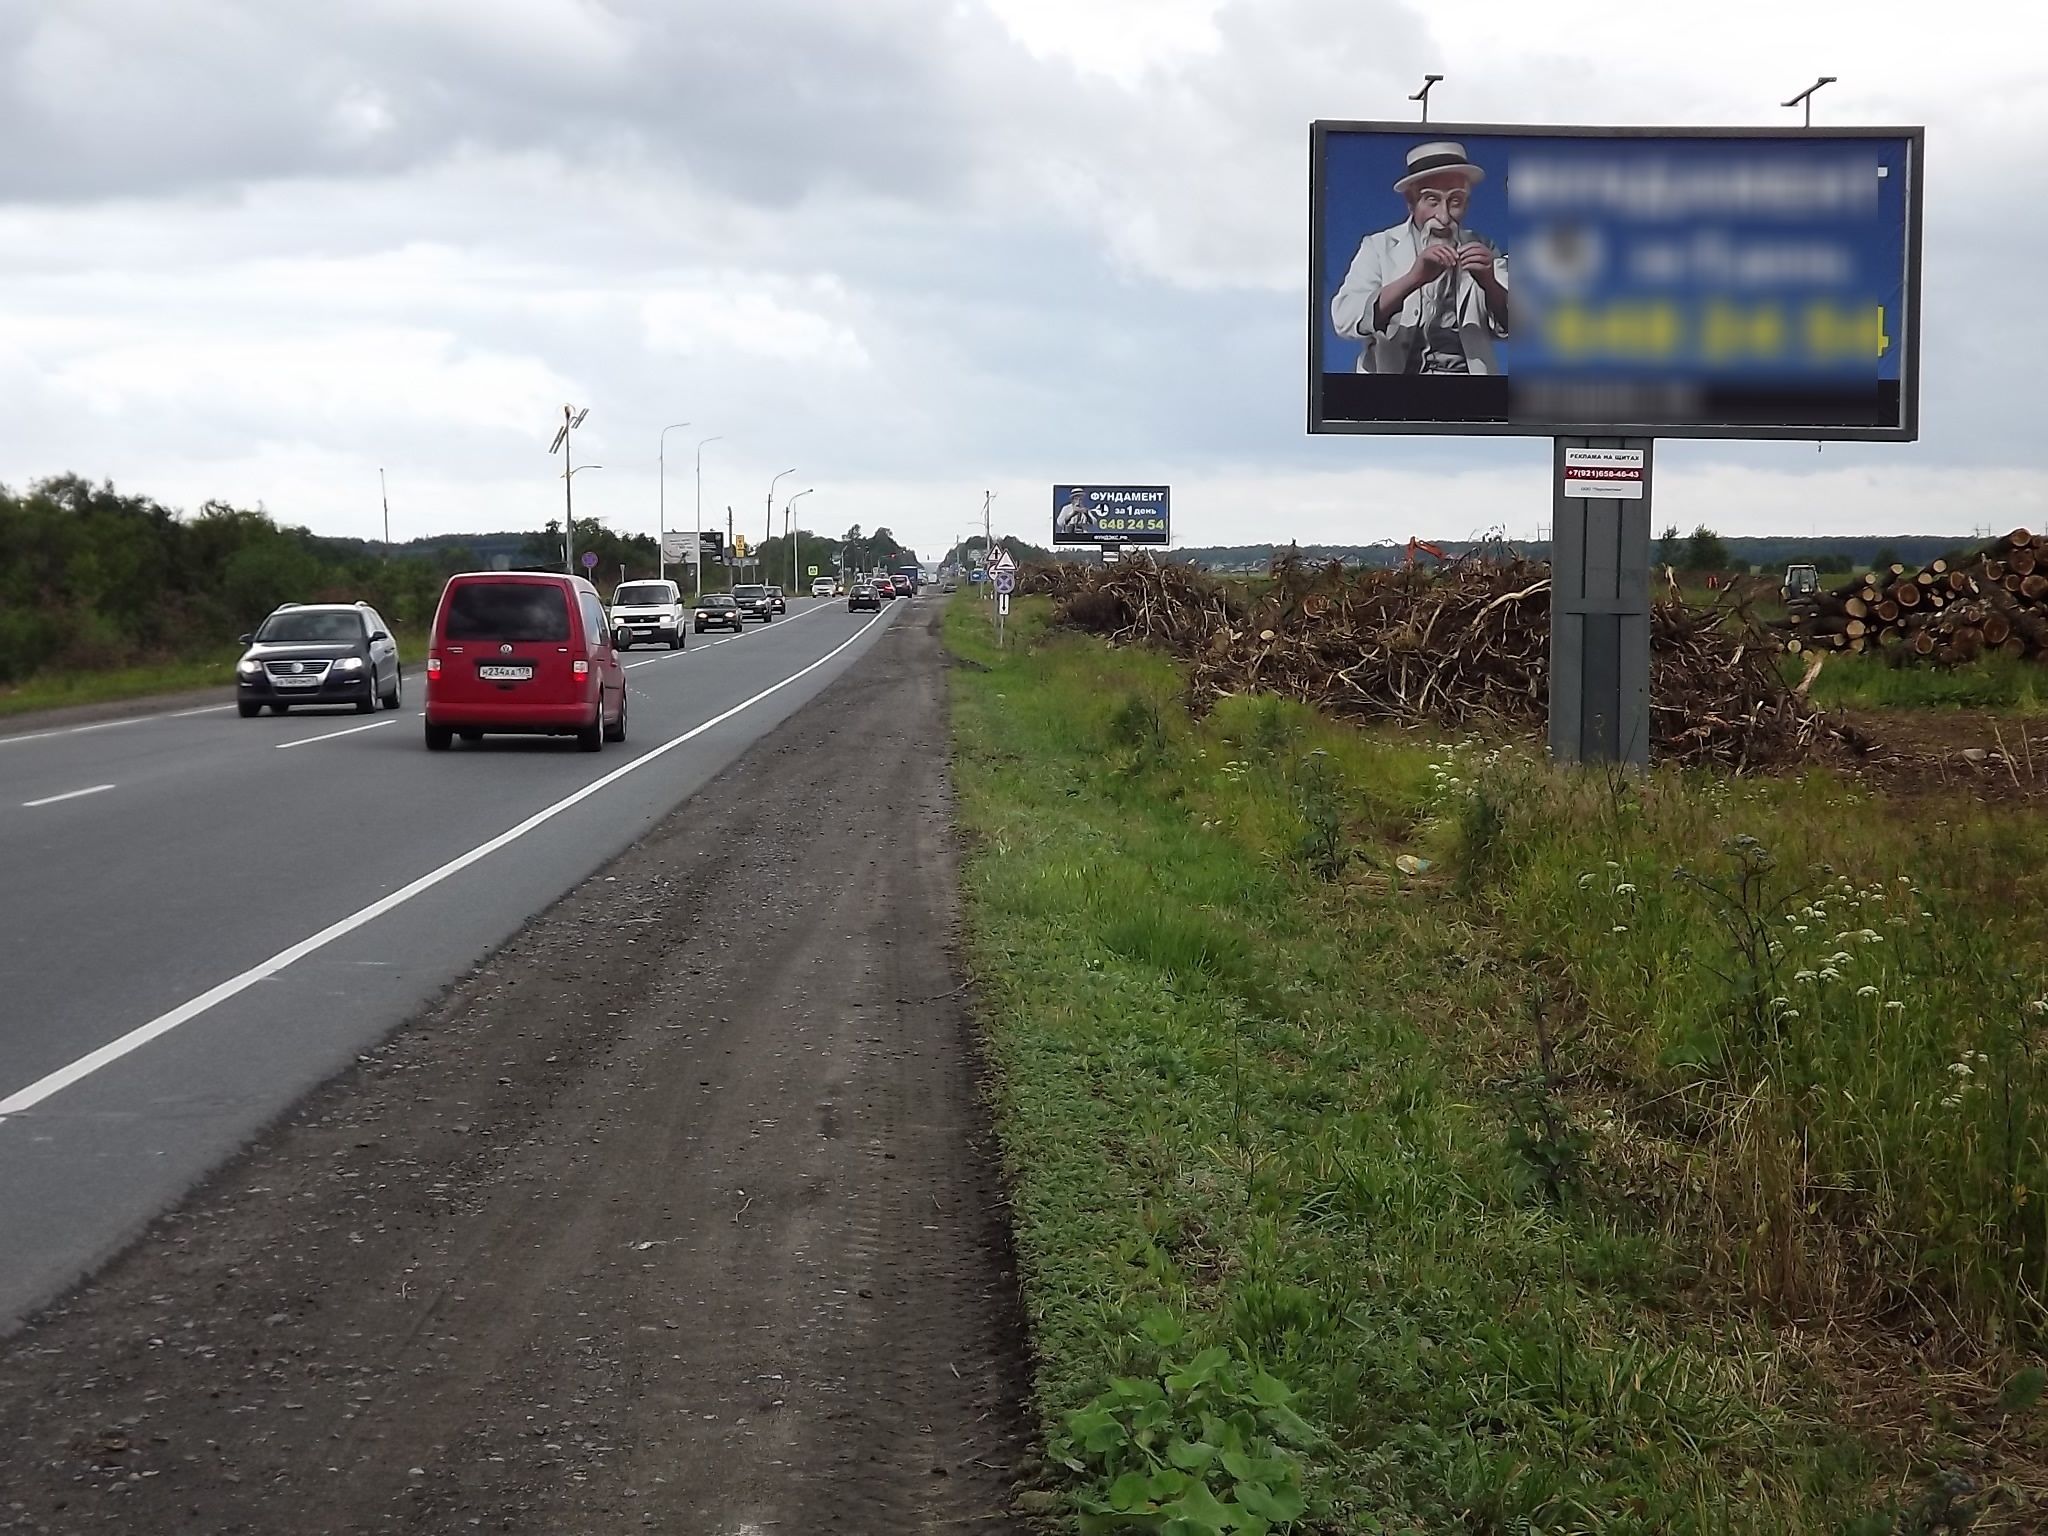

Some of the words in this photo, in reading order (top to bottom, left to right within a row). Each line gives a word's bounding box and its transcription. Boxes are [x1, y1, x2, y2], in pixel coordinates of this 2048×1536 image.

[1090, 492, 1164, 503] ФУНДАМЕНТ
[1127, 505, 1133, 516] 1
[1134, 507, 1157, 515] день
[1099, 519, 1125, 530] 648
[1127, 519, 1144, 530] 24
[1147, 519, 1165, 530] 54
